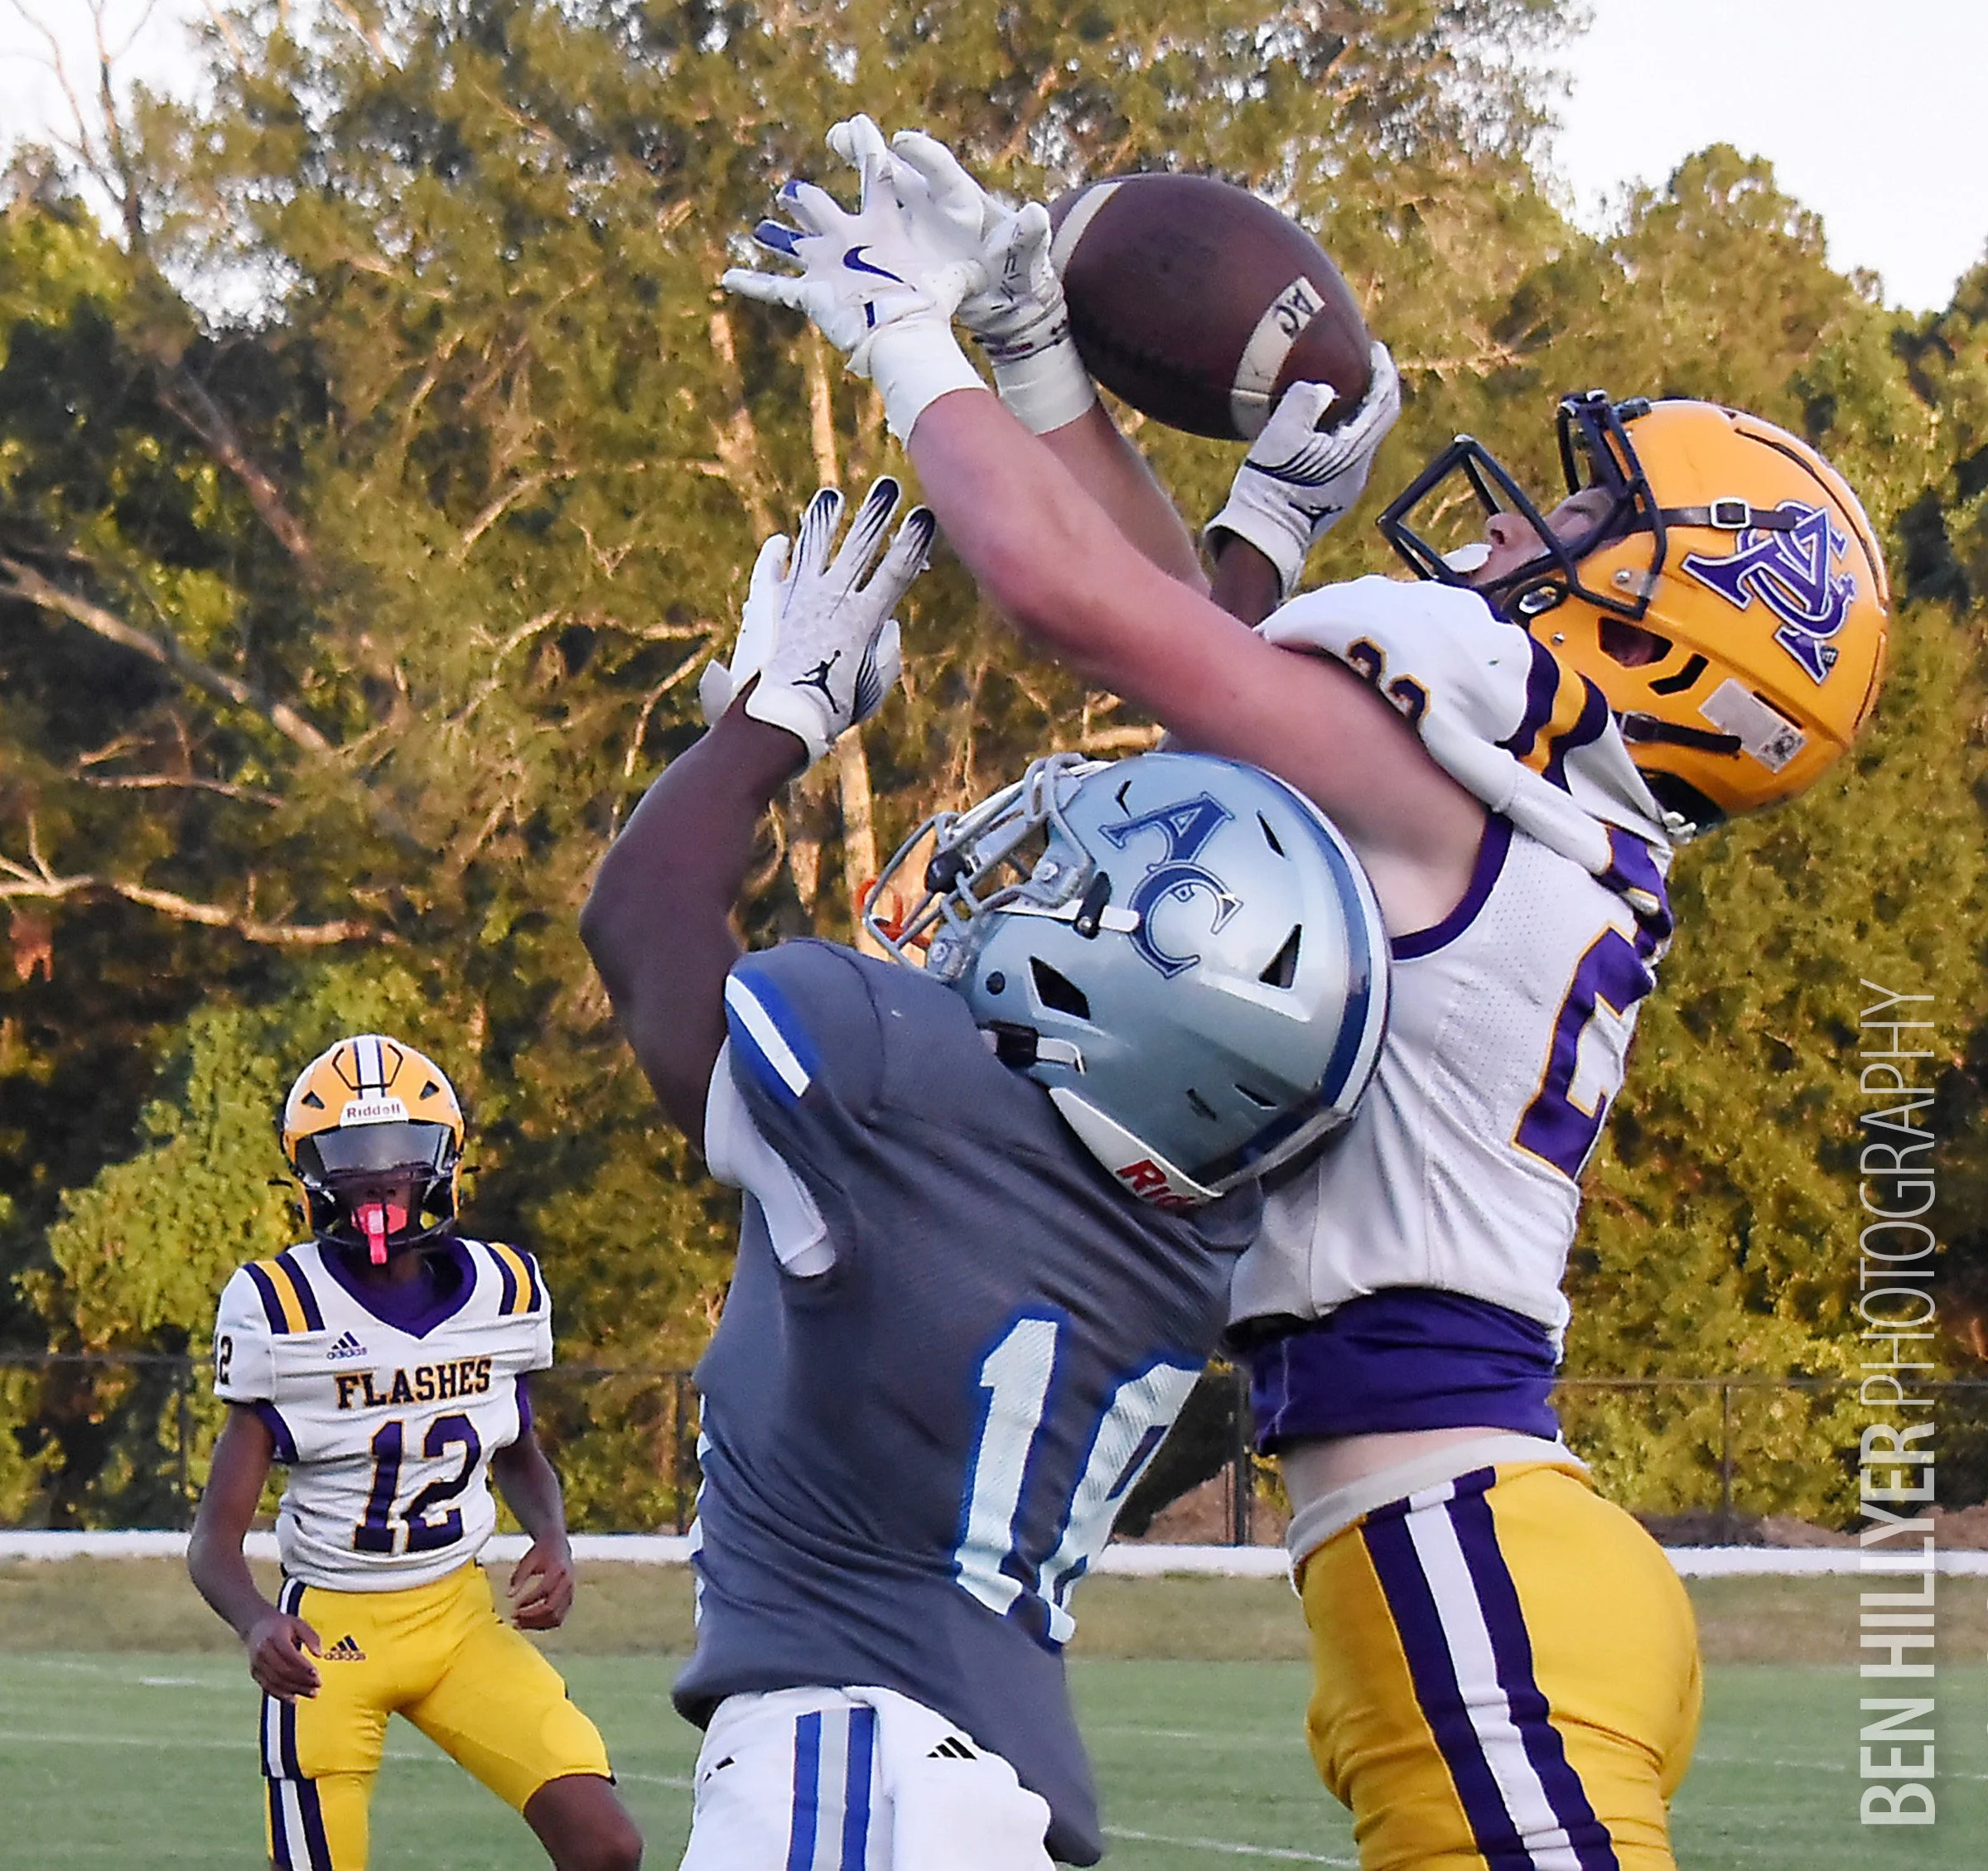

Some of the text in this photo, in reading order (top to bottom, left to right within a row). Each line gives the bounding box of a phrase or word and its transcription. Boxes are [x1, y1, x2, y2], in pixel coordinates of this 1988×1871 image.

[346, 1103, 400, 1118] Riddell
[326, 1346, 367, 1361] adidas
[335, 1357, 493, 1410] FLASHES
[352, 1412, 481, 1554] 12
